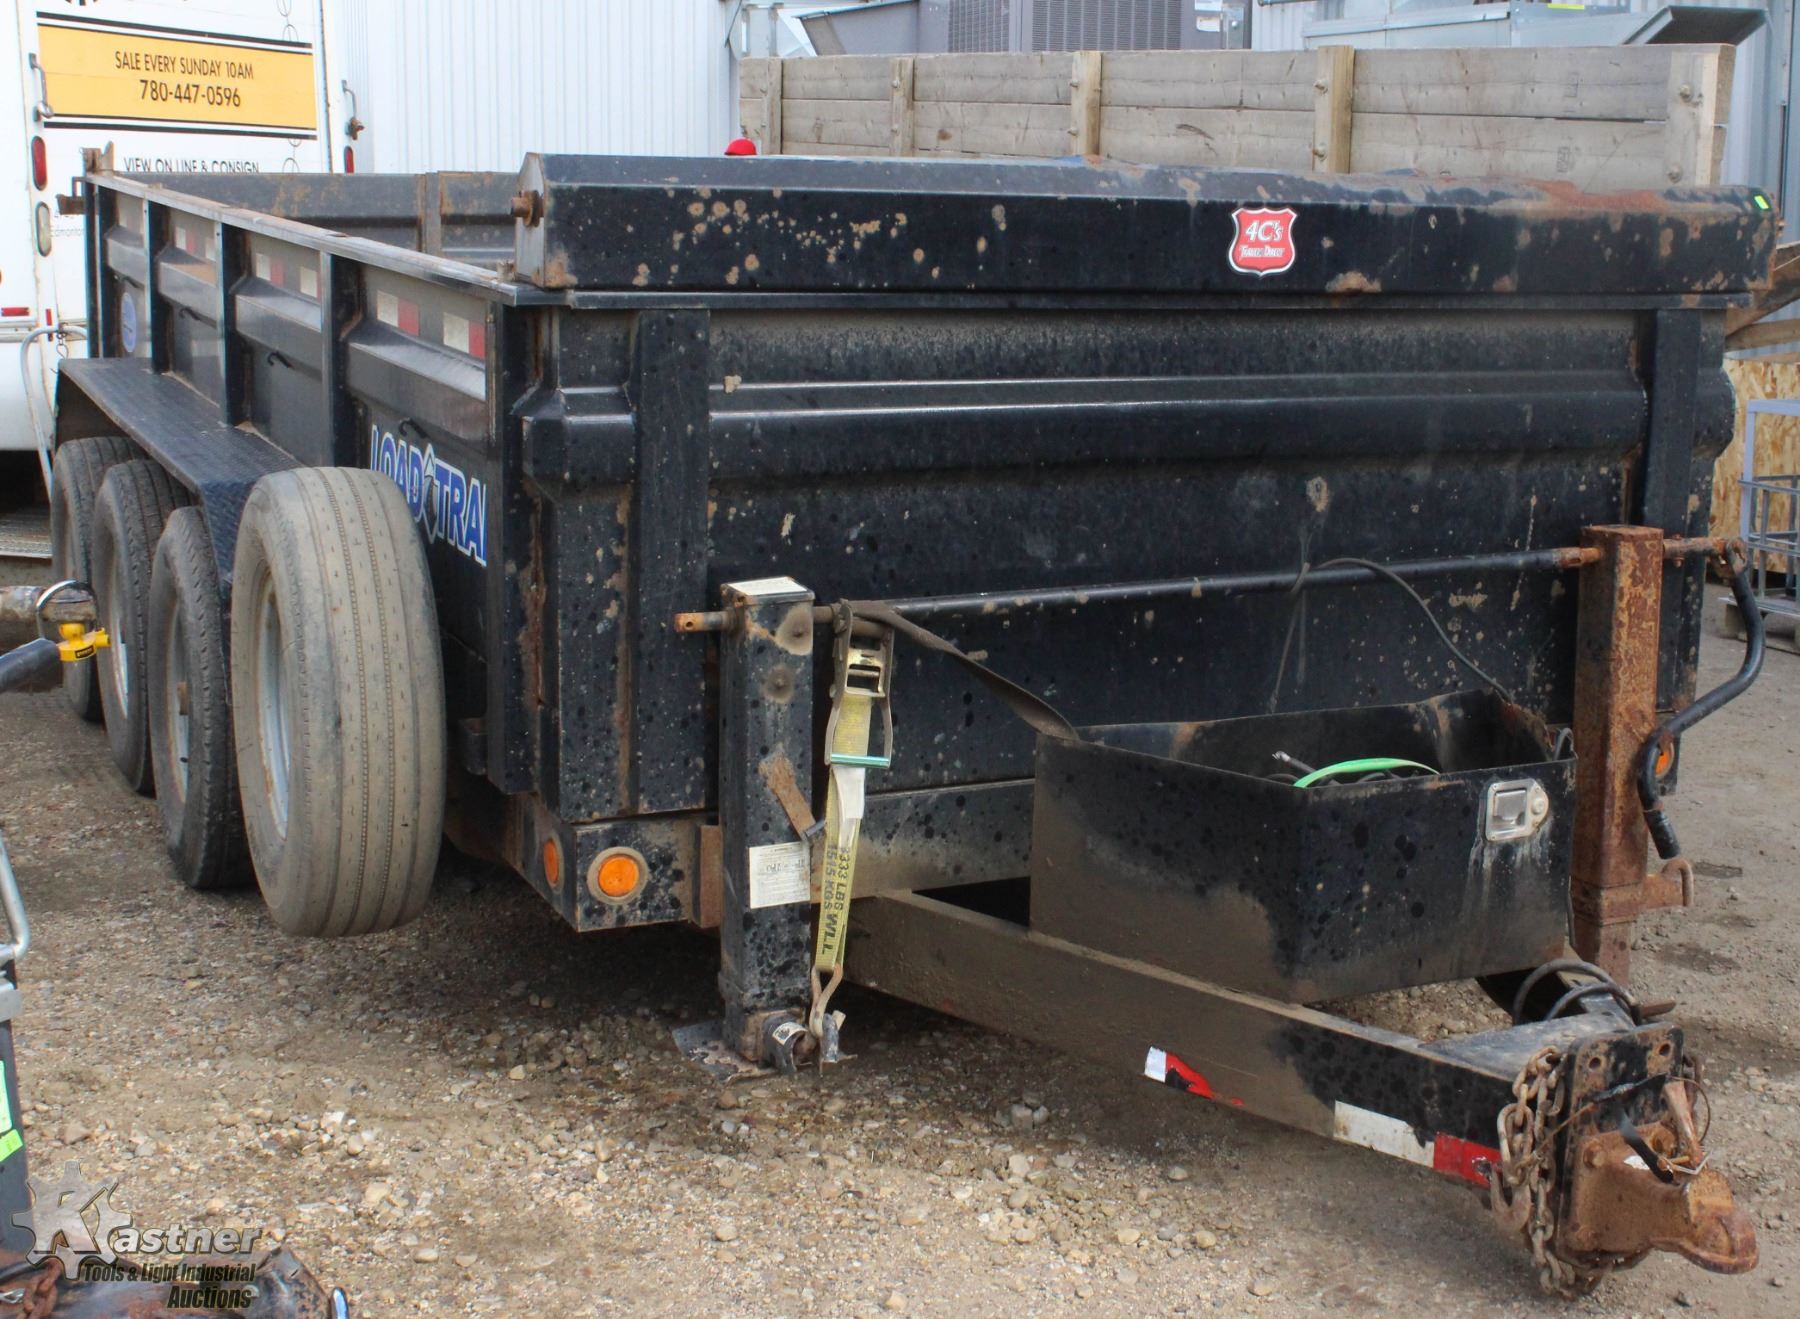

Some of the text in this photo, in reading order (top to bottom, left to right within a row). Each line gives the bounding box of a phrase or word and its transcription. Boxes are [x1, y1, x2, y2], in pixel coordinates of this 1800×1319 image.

[115, 51, 254, 80] SALE EVERY SUNDAY 10AM
[140, 79, 241, 107] 780-447-0596
[124, 157, 152, 172] VIEW
[155, 158, 173, 172] ON
[211, 160, 260, 173] CONSIGN
[1245, 219, 1284, 241] 4C's
[834, 882, 847, 911] LBS
